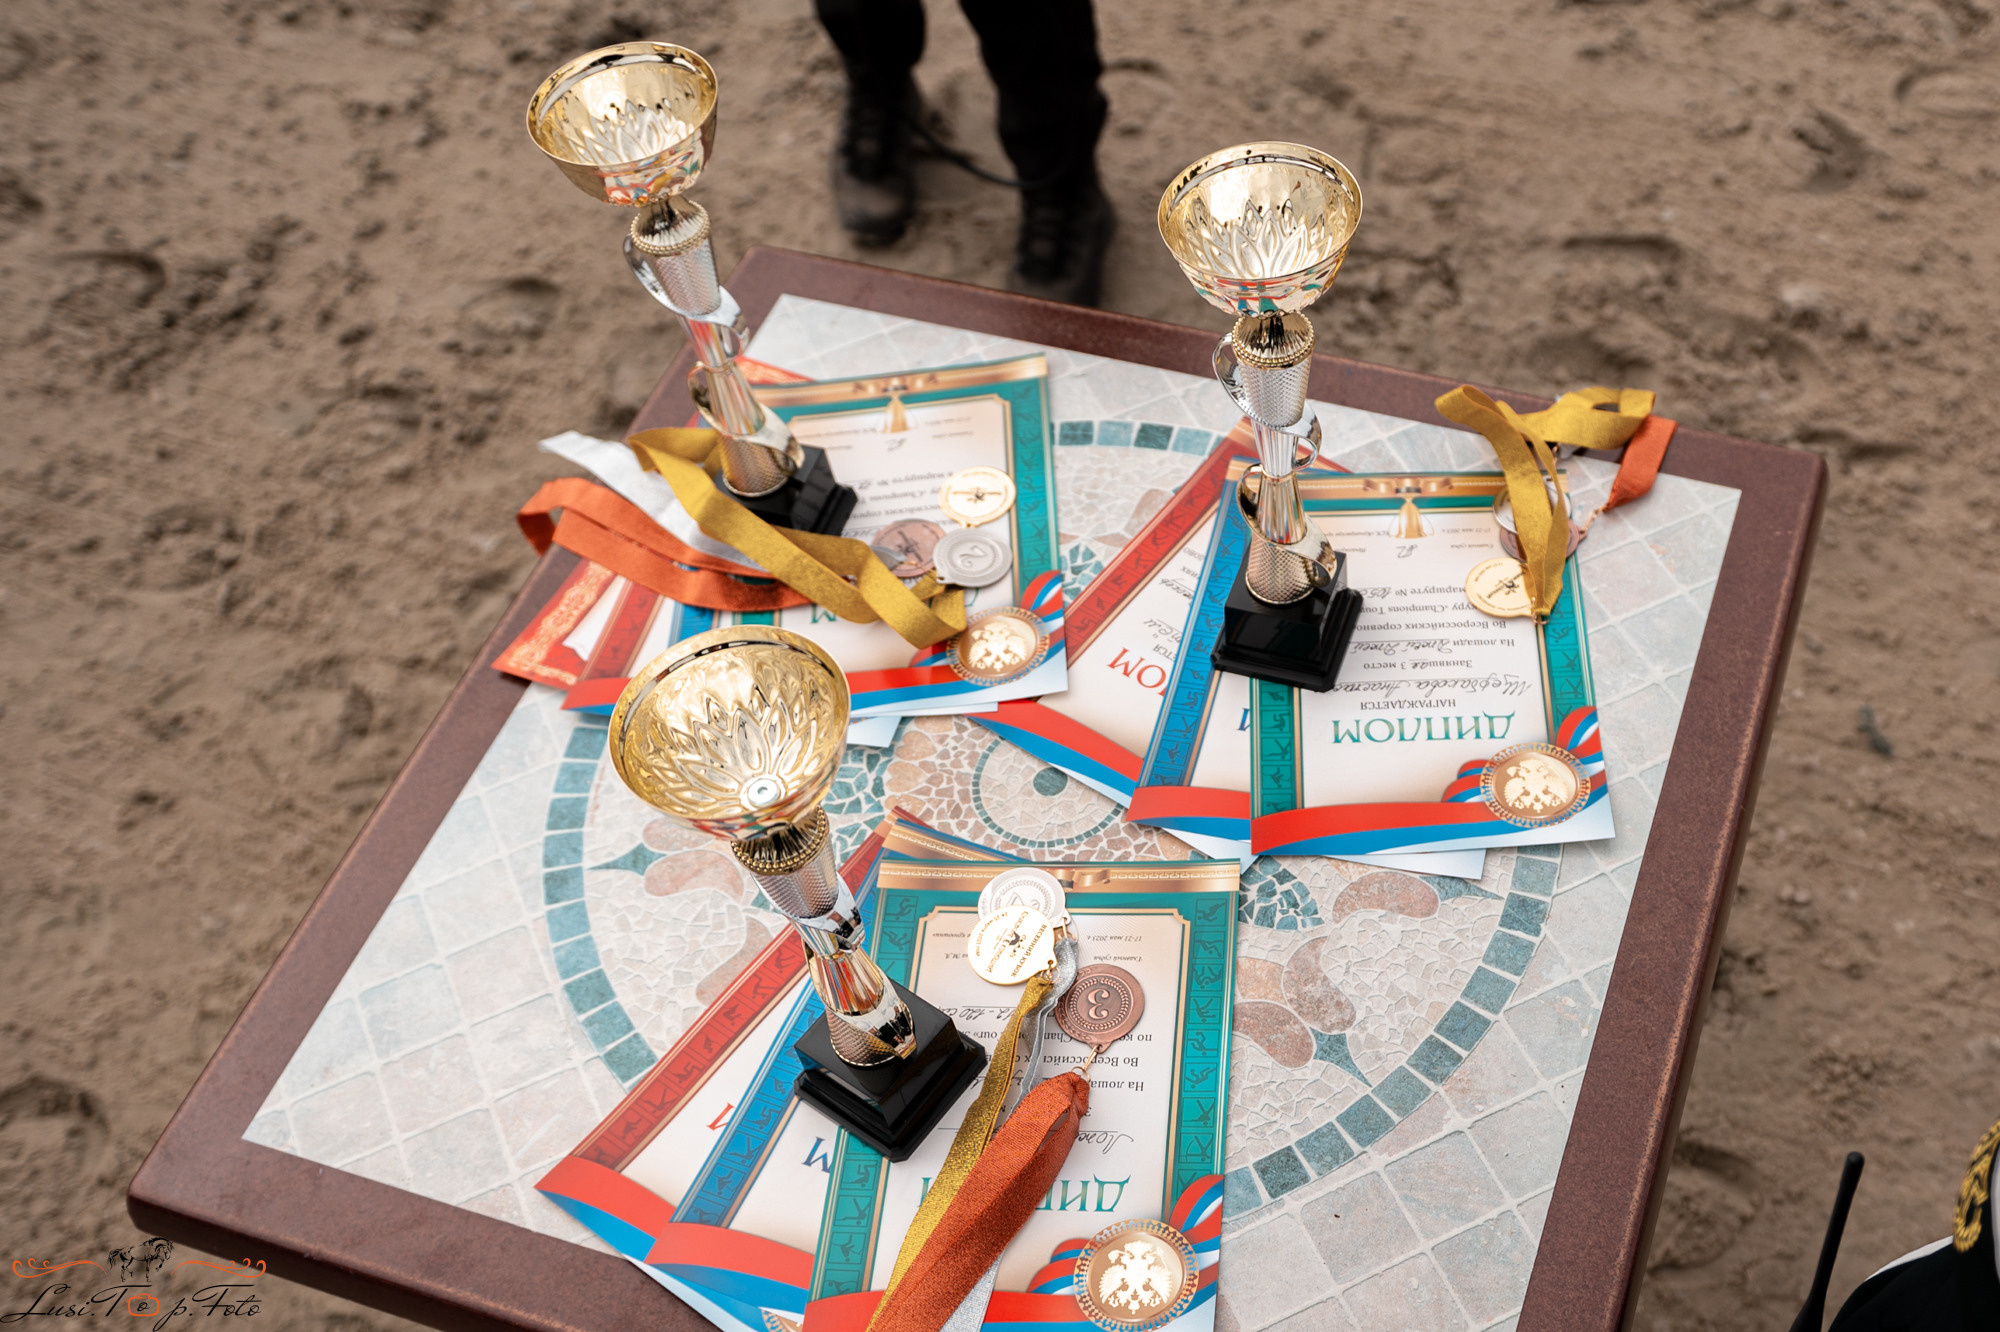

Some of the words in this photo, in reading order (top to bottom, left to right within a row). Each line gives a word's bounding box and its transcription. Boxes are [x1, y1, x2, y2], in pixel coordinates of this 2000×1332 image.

[1405, 620, 1489, 632] Всероссийских
[1492, 621, 1506, 629] Во
[1453, 638, 1498, 647] лошади
[1499, 639, 1515, 648] На
[1363, 662, 1397, 670] место
[1400, 662, 1406, 670] 3
[1360, 699, 1456, 711] НАГРАЖДАЕТСЯ
[1331, 710, 1516, 744] ДИПЛОМ
[1094, 954, 1112, 963] судья
[1087, 988, 1110, 1020] 3
[1137, 1033, 1152, 1042] по
[1123, 1056, 1139, 1067] Во
[1127, 1081, 1144, 1092] На
